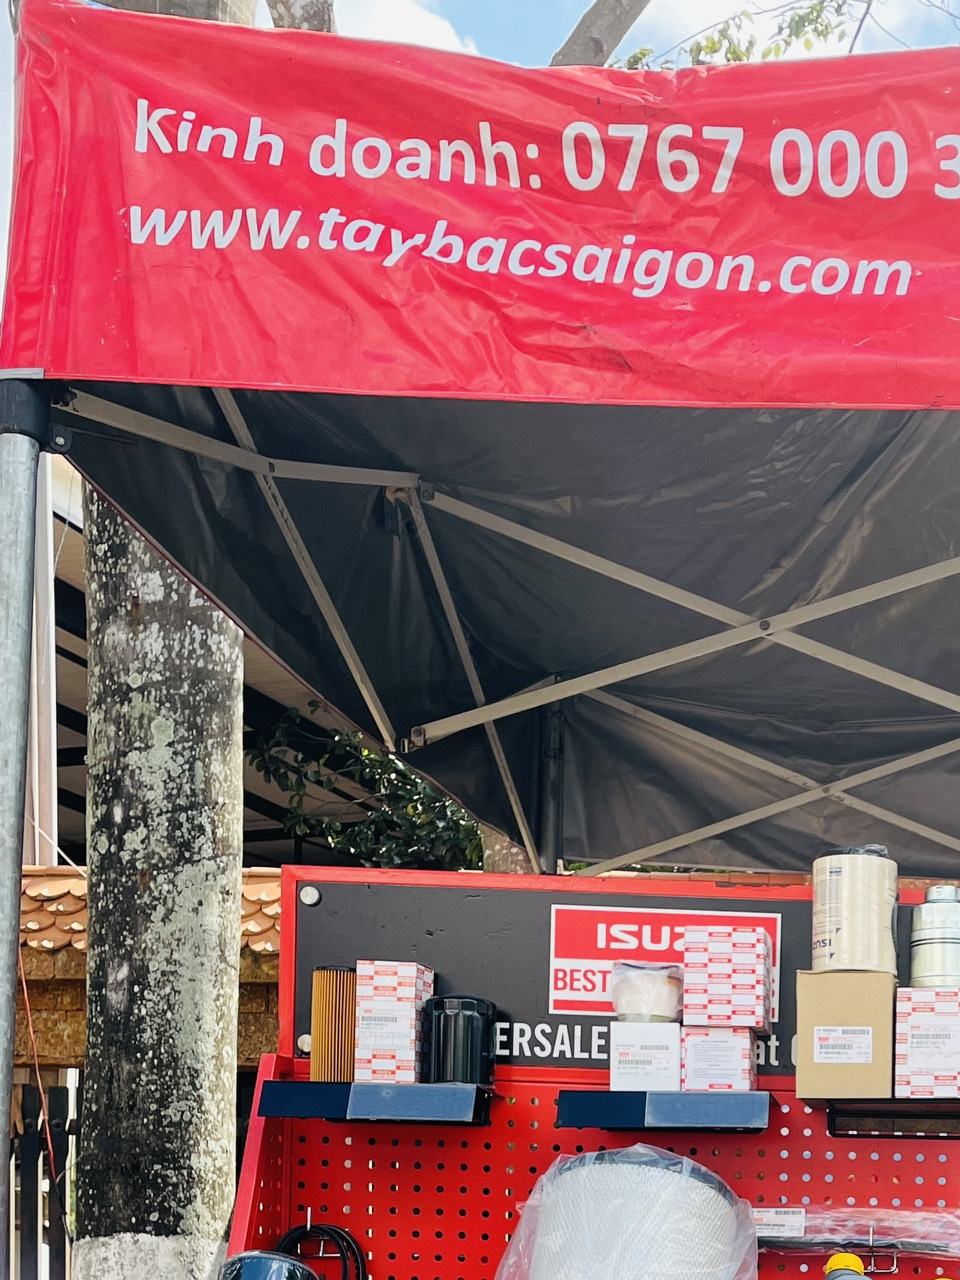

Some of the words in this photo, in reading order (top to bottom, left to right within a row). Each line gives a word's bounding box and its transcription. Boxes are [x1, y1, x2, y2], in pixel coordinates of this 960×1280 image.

[136, 99, 283, 166] Kinh
[310, 119, 541, 189] doanh:
[563, 122, 743, 193] 0767
[770, 129, 909, 199] 000
[131, 206, 912, 298] www.taybacsaigon.com
[553, 968, 612, 993] BEST
